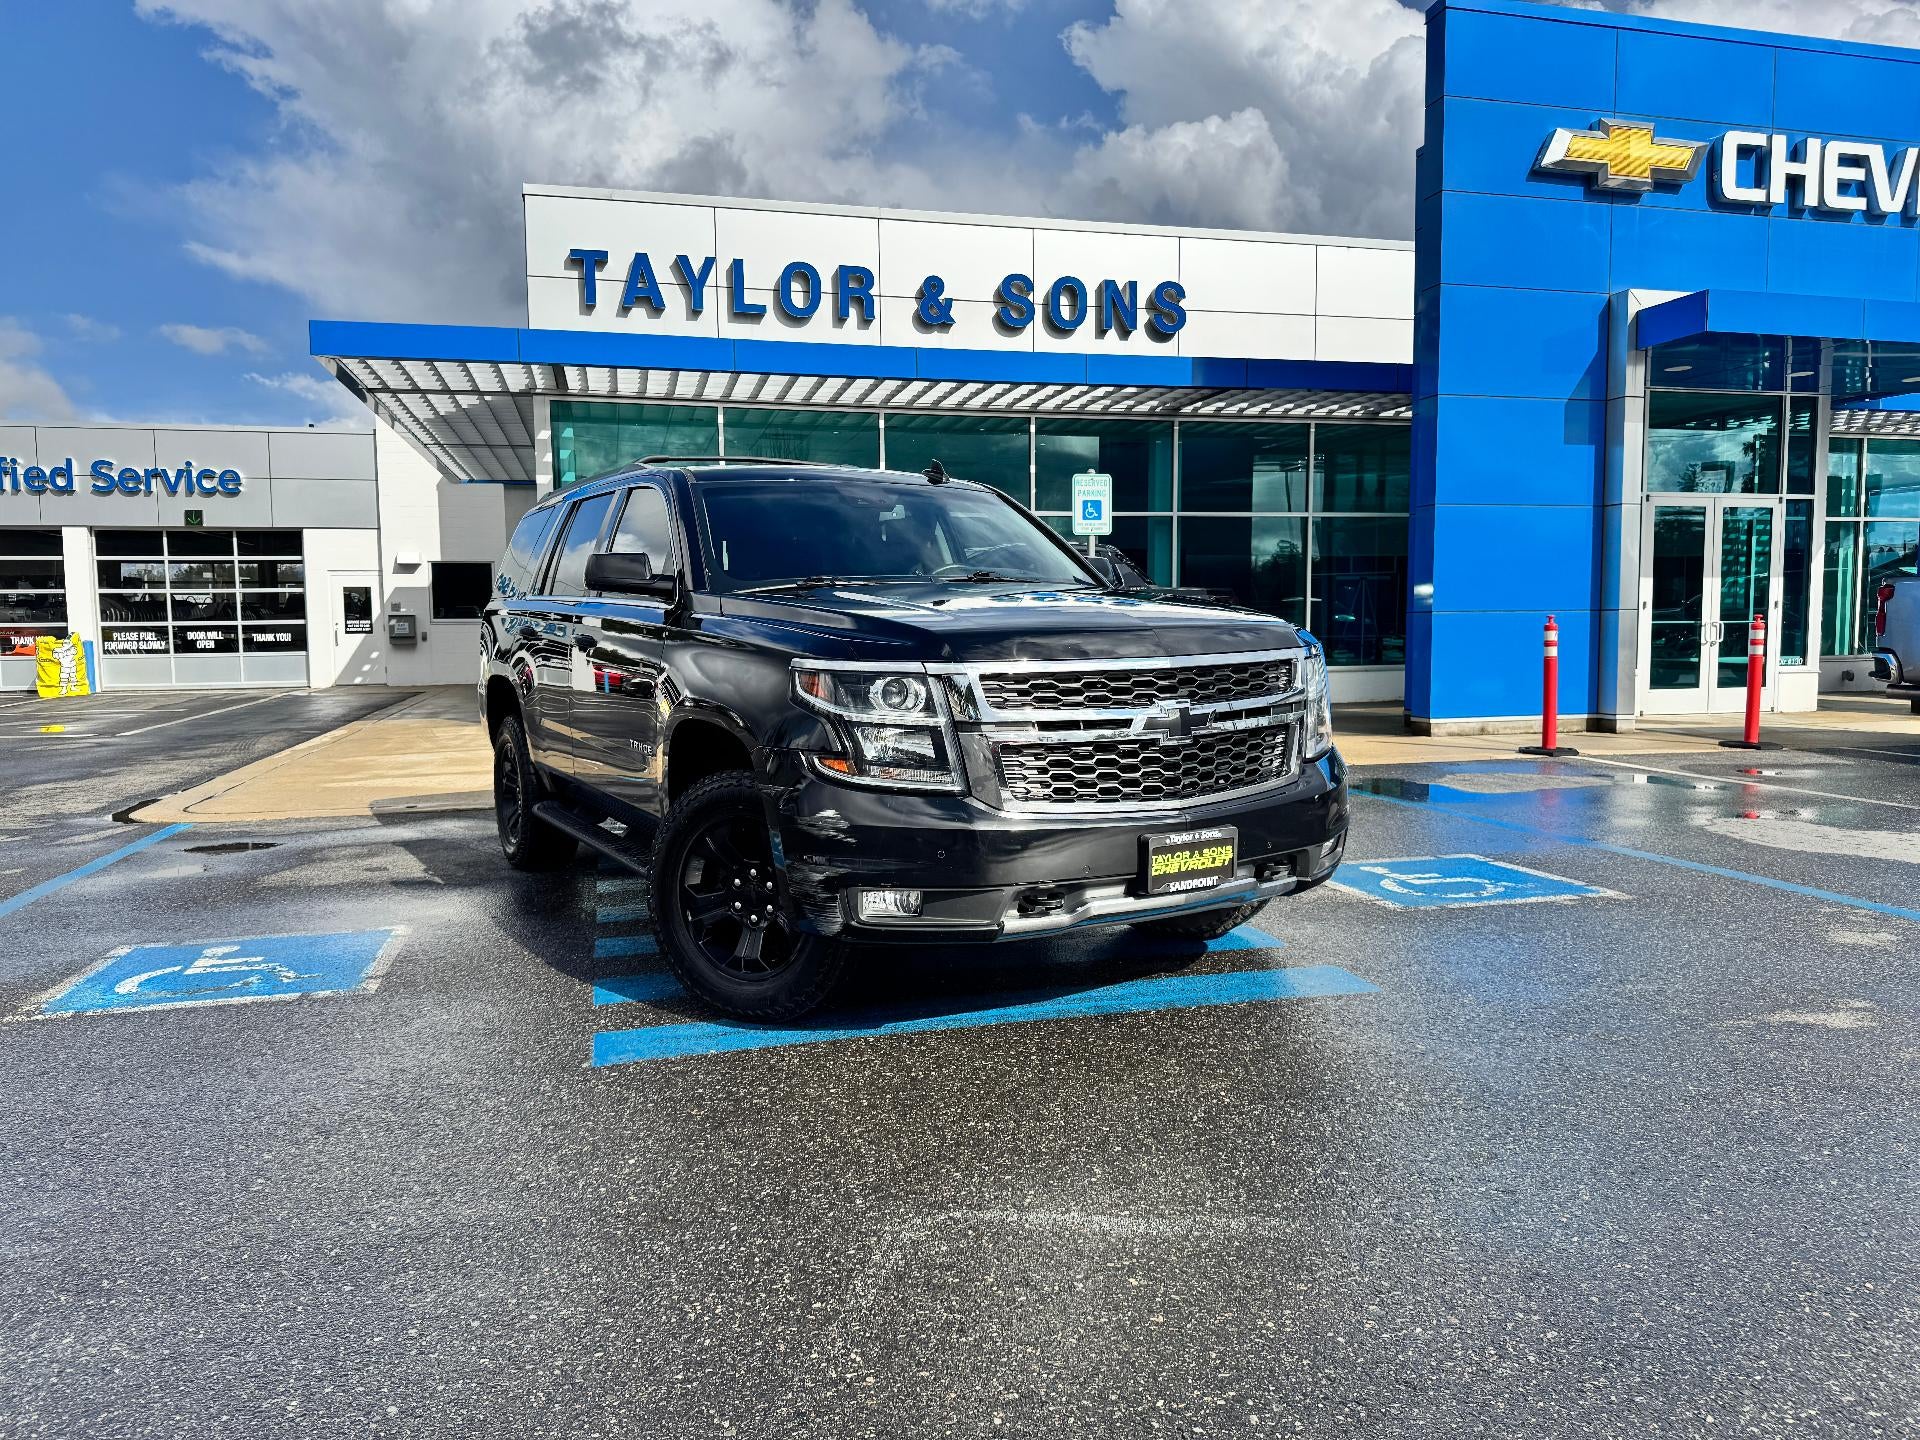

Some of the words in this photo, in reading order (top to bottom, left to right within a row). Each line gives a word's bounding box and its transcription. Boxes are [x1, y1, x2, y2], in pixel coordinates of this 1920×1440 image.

[1721, 130, 1920, 215] CHEV
[569, 249, 876, 321] TAYLOR
[918, 275, 955, 325] &
[999, 273, 1188, 335] SONS
[91, 460, 241, 493] Service
[1076, 479, 1107, 487] RESERVED
[10, 636, 35, 645] THANK
[112, 631, 139, 641] PLEASE
[139, 631, 158, 641] PULL
[186, 631, 206, 641] DOOR
[206, 630, 224, 640] WILL
[251, 633, 276, 642] THANK
[275, 632, 292, 642] YOU!
[104, 641, 138, 650] FORWARD
[138, 640, 166, 650] SLOWLY
[196, 640, 215, 649] OPEN
[1169, 833, 1194, 844] Taylor
[1152, 851, 1190, 866] TAYLOR
[1202, 845, 1233, 857] SONS
[1152, 854, 1233, 876] CHEVROLET
[1169, 876, 1219, 892] SANDPOINT
